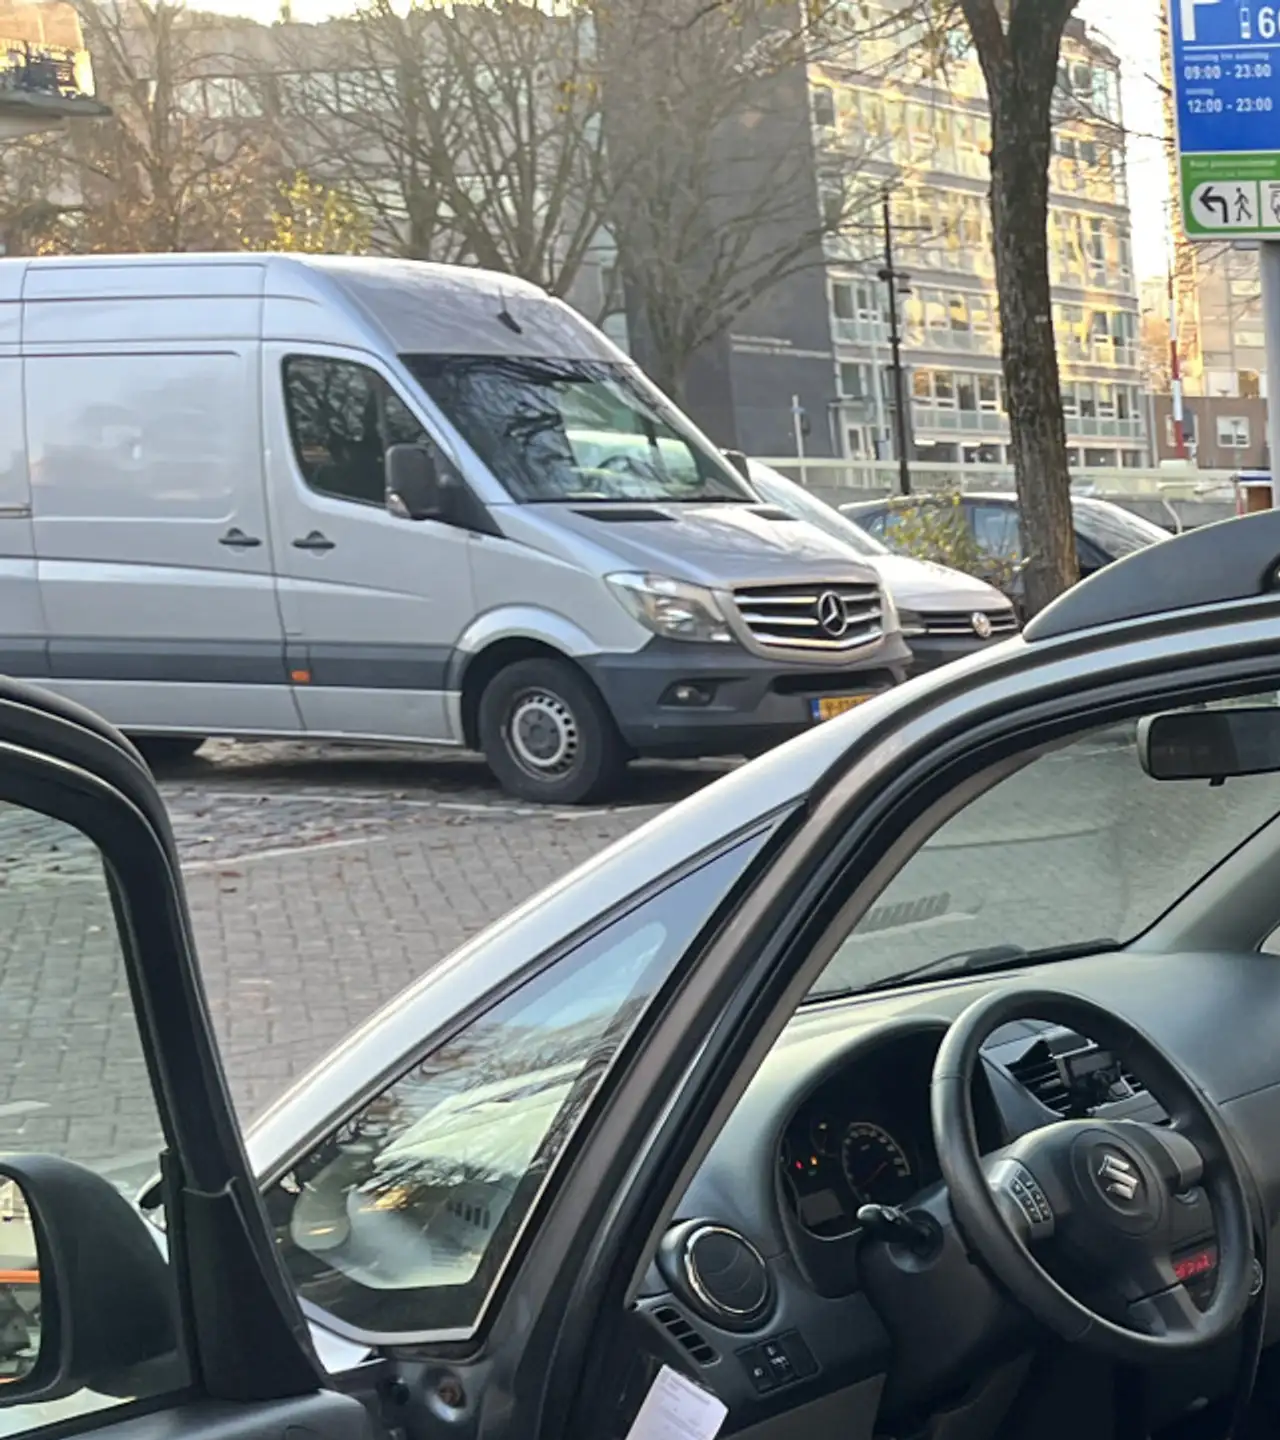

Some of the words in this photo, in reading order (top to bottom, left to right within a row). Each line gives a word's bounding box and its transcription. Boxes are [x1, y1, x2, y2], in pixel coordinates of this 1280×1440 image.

[1234, 63, 1272, 79] 23:00
[1187, 98, 1223, 114] 12:00
[1236, 96, 1273, 112] 23:00
